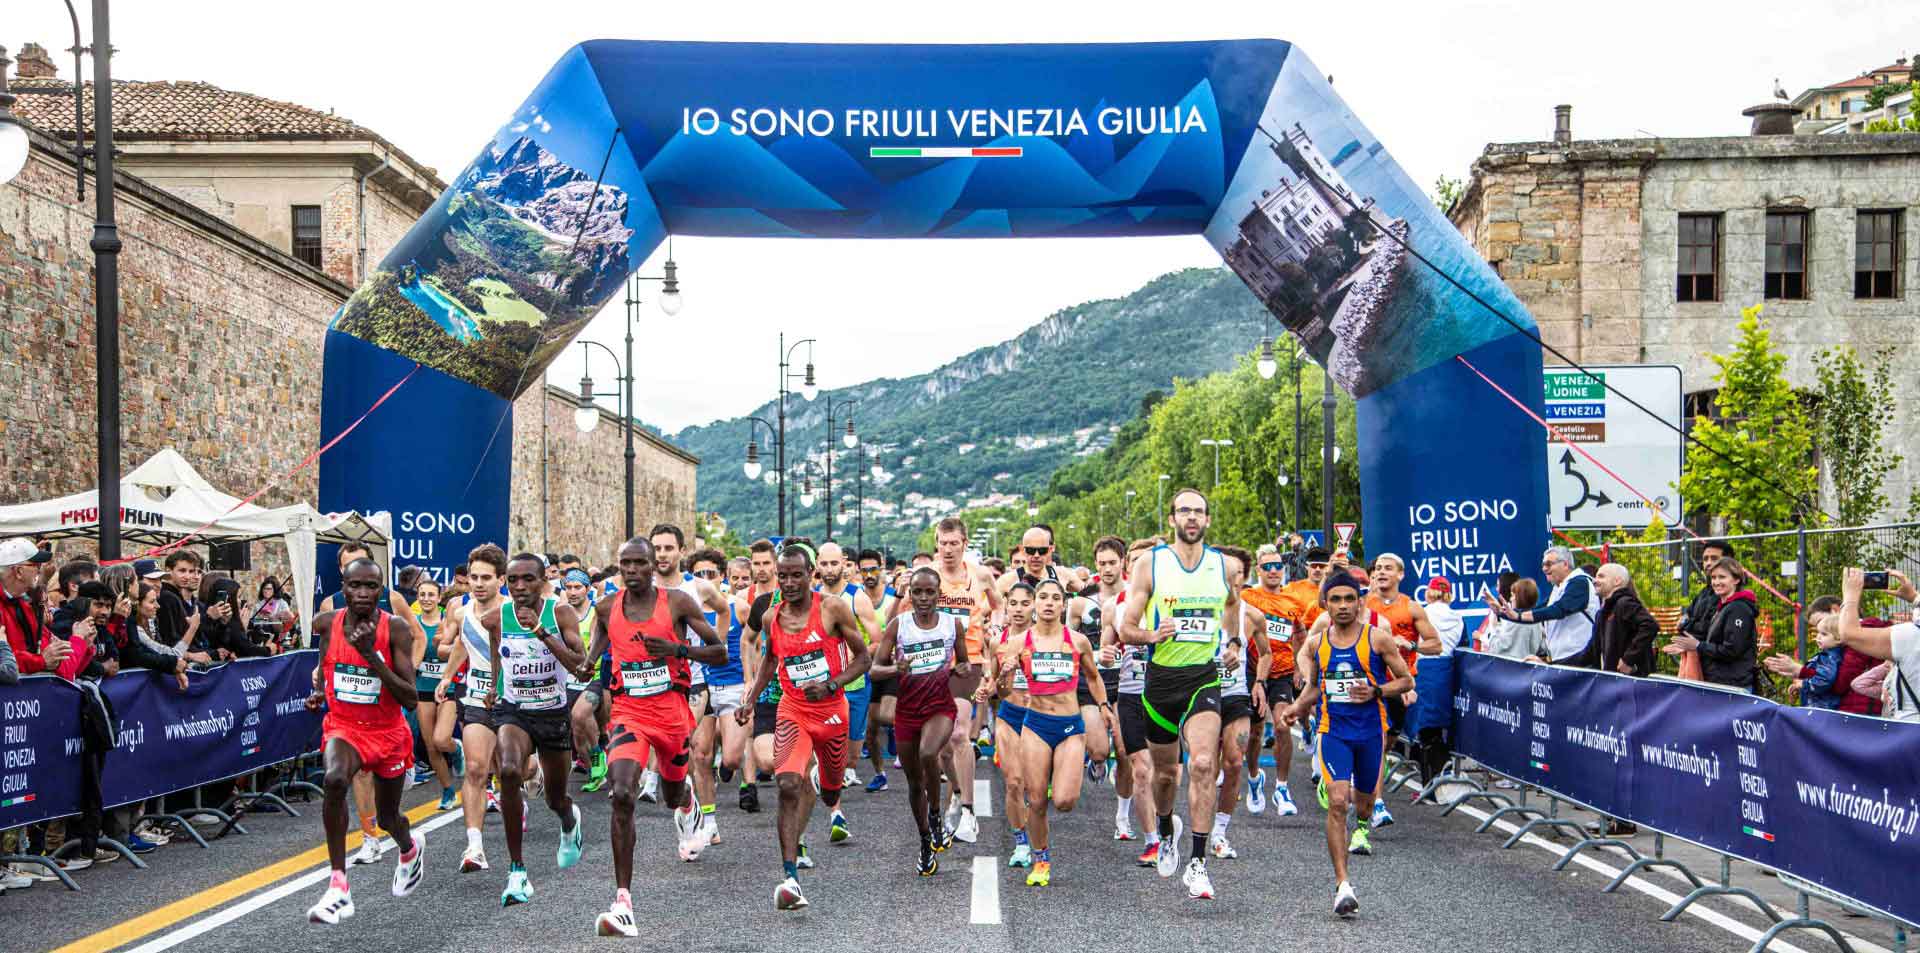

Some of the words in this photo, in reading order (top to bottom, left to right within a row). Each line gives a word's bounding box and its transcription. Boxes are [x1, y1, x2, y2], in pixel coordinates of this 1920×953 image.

[683, 107, 720, 135] IO
[729, 107, 835, 137] SONO
[846, 109, 937, 137] FRIULI
[949, 109, 1088, 137] VENEZIA
[1097, 104, 1207, 136] GIULIA
[1553, 387, 1588, 398] UDINE
[1553, 405, 1602, 417] VENEZIA
[401, 511, 475, 534] SONO
[1409, 504, 1436, 526] IO
[1444, 499, 1518, 523] SONO
[1411, 528, 1478, 552] FRIULI
[1411, 553, 1514, 579] VENEZIA
[1181, 620, 1207, 631] 247
[1268, 622, 1286, 633] 201
[424, 664, 441, 673] 107
[512, 661, 556, 675] Cetilar
[624, 668, 667, 680] KIPROTICH
[795, 662, 817, 671] EDRIS
[341, 675, 372, 686] KIPROP
[4, 701, 15, 719] IO
[16, 699, 40, 718] SONO
[1477, 699, 1521, 734] www.turismofvg.it
[5, 724, 27, 745] FRIULI
[165, 709, 234, 741] www.turismofvg.it
[1733, 719, 1743, 739] IO
[1742, 720, 1767, 743] SONO
[1566, 724, 1628, 764] www.turismofvg.it
[4, 746, 36, 769] VENEZIA
[1641, 743, 1720, 787] www.turismofvg.it
[1737, 745, 1757, 769] FRIULI
[2, 772, 28, 794] GIULIA
[1739, 772, 1769, 799] VENEZIA
[1741, 800, 1765, 825] GIULIA
[1796, 780, 1920, 842] www.turismofvg.it
